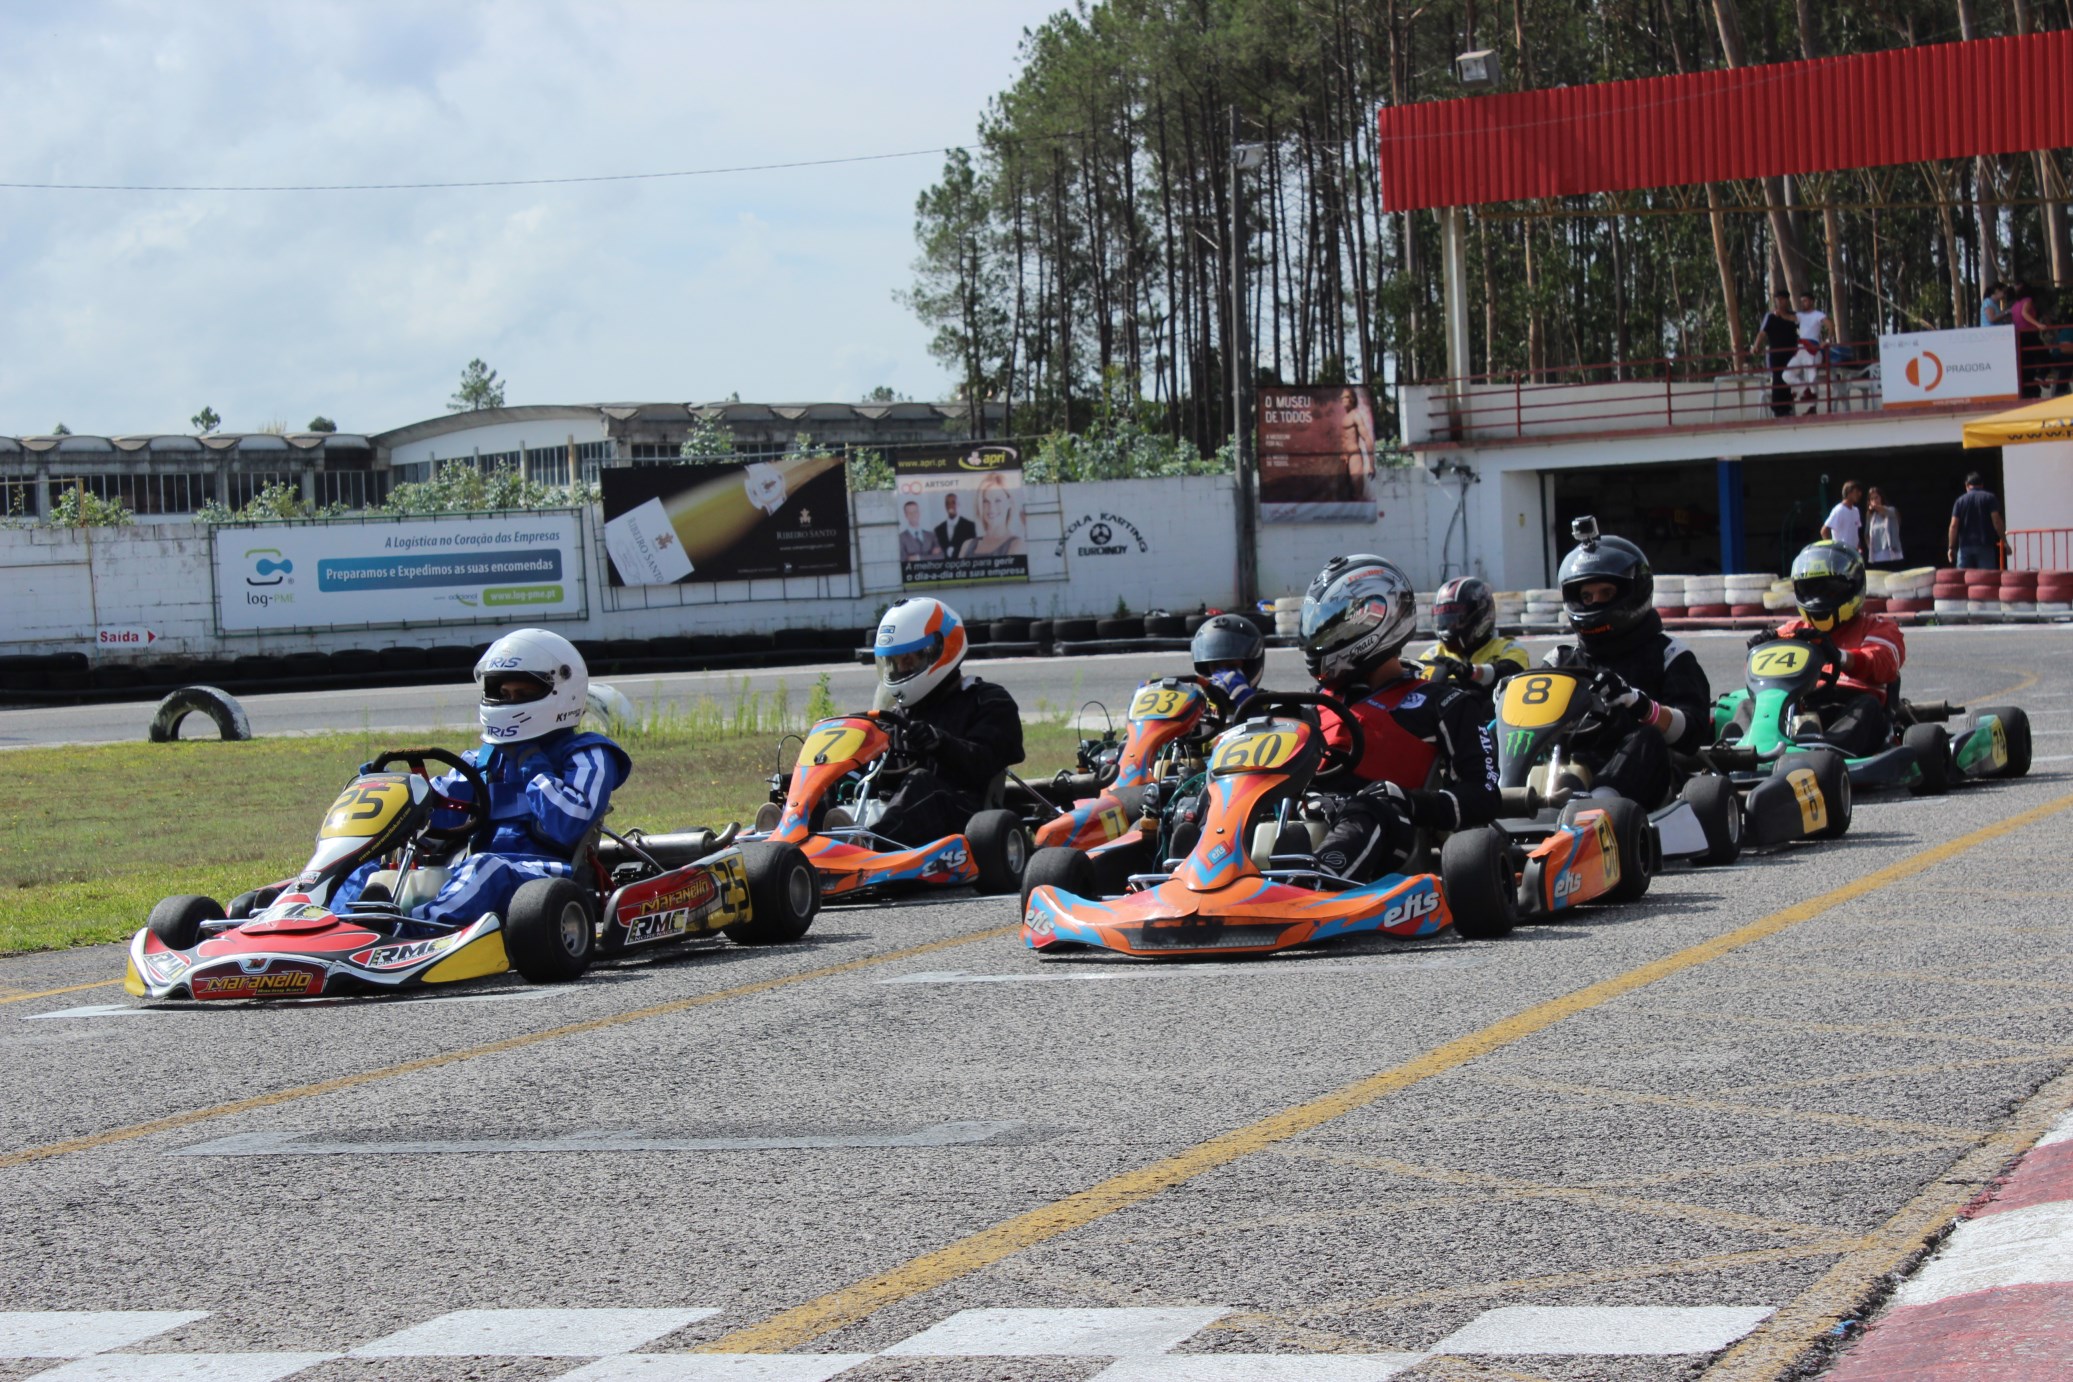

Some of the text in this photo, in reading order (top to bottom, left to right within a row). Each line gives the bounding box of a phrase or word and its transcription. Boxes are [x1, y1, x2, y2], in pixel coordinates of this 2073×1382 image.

[1946, 362, 1992, 374] PRAGOSA
[1265, 396, 1311, 408] O MUSEU
[1265, 411, 1312, 423] DE TODOS
[898, 459, 946, 468] www.apri.pt
[983, 451, 1006, 466] apri
[925, 480, 959, 488] ARTSOFT
[385, 537, 392, 548] A
[440, 537, 452, 546] no
[454, 533, 493, 547] Coração
[495, 532, 512, 544] das
[514, 530, 560, 545] Empresas
[1100, 513, 1148, 553] KARTING
[326, 559, 553, 582] Preparamos e Expedimos as suas encomendas
[914, 561, 943, 570] melhor
[972, 559, 992, 568] para
[994, 557, 1015, 568] gerir
[955, 570, 967, 578] da
[987, 568, 1025, 577] empresa
[1758, 651, 1798, 671] 74
[1522, 677, 1552, 705] 8
[1136, 692, 1179, 714] 93
[816, 730, 847, 759] 7
[1220, 734, 1282, 767] 60
[324, 786, 391, 829] 25
[207, 972, 313, 990] Maranello
